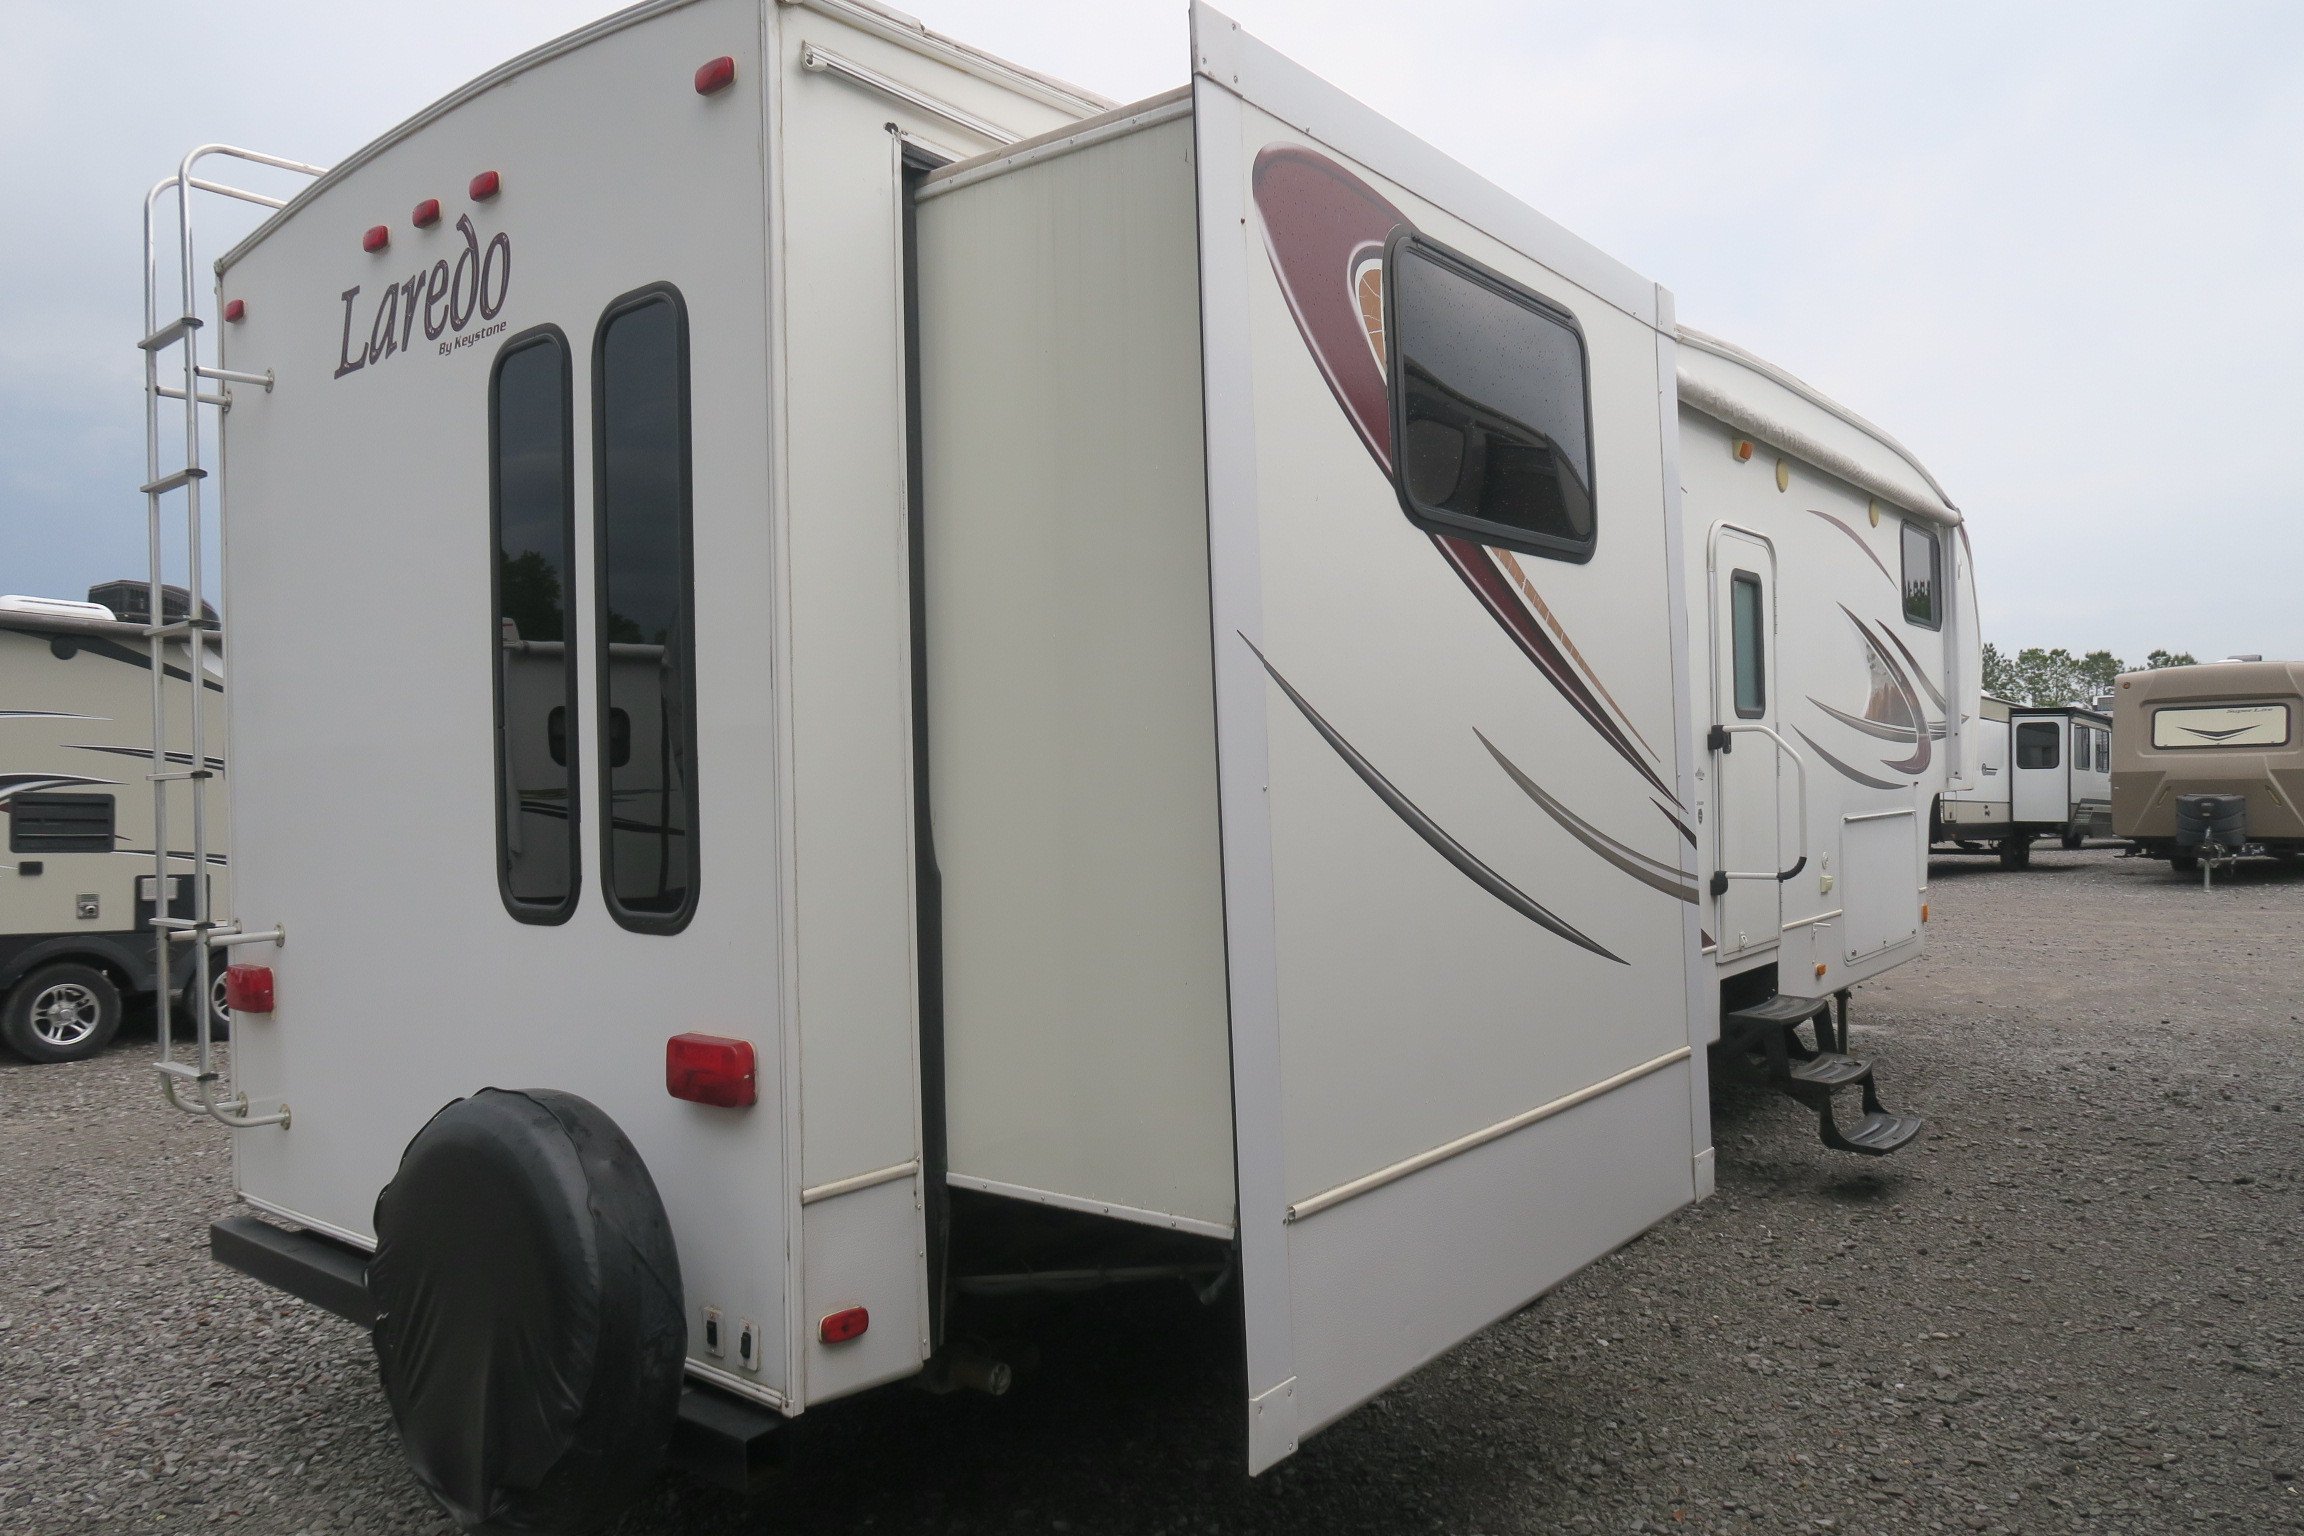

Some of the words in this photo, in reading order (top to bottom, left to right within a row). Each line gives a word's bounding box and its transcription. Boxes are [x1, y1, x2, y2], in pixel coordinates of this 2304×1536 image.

[334, 213, 511, 380] Laredo
[439, 342, 452, 356] By
[454, 321, 507, 349] Keystone
